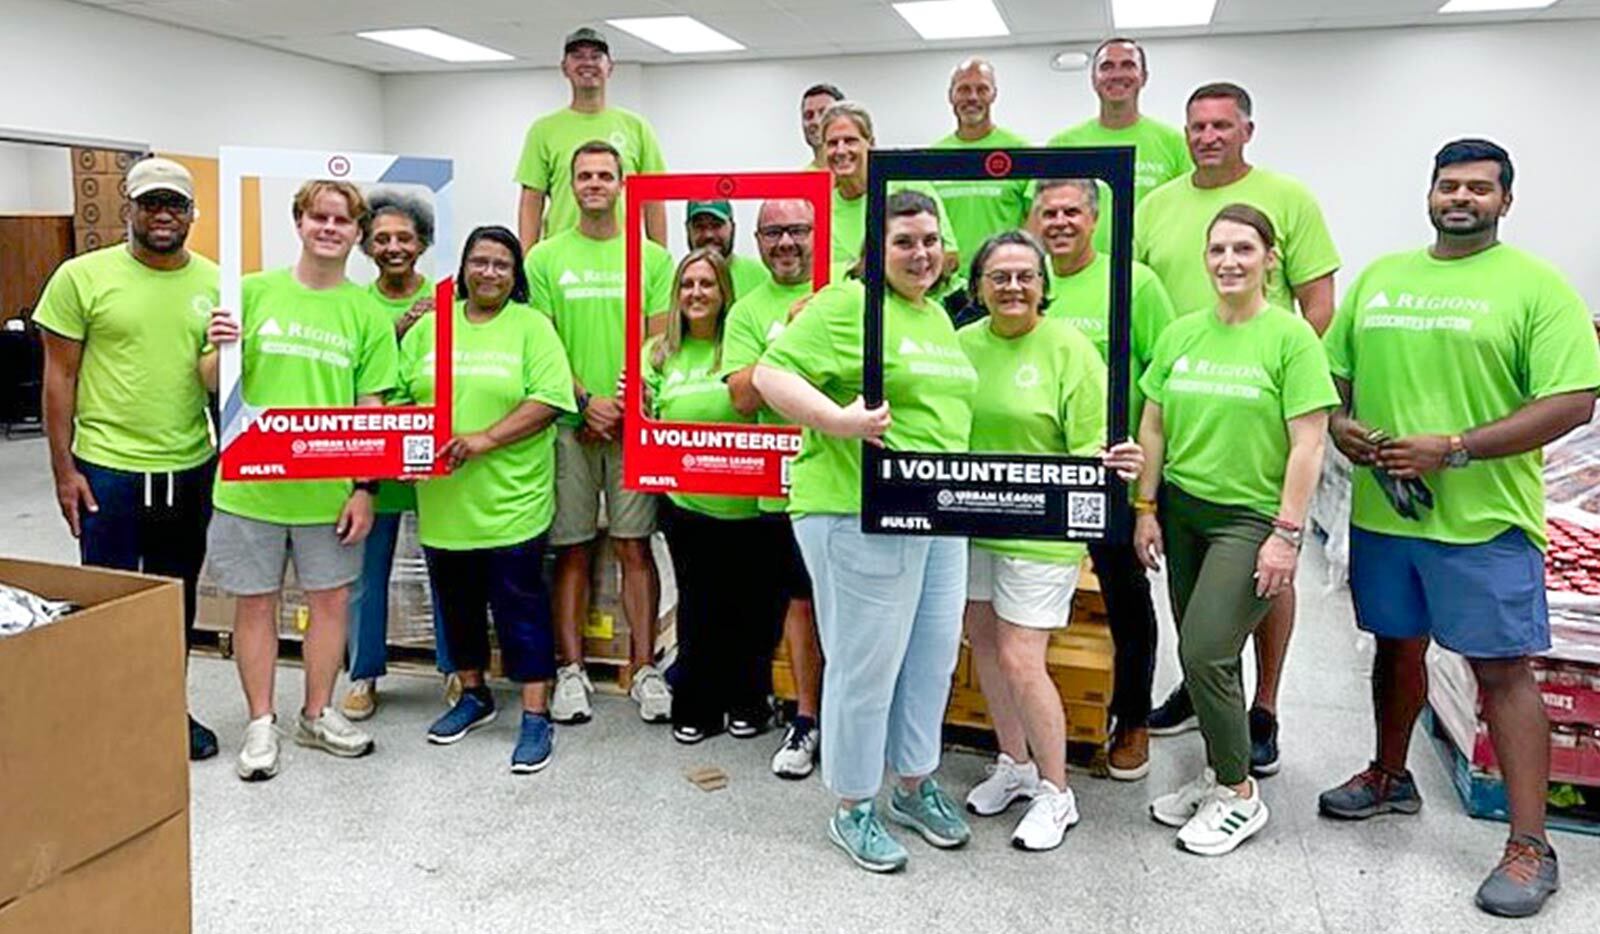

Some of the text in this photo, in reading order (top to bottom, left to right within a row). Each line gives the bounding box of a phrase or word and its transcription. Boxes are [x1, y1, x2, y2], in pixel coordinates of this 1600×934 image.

[241, 414, 435, 433] I VOLUNTEERED!
[640, 429, 648, 445] I
[882, 459, 1105, 486] I VOLUNTEERED!
[955, 491, 1046, 504] URBAN LEAGUE
[880, 516, 931, 530] #ULSTL
